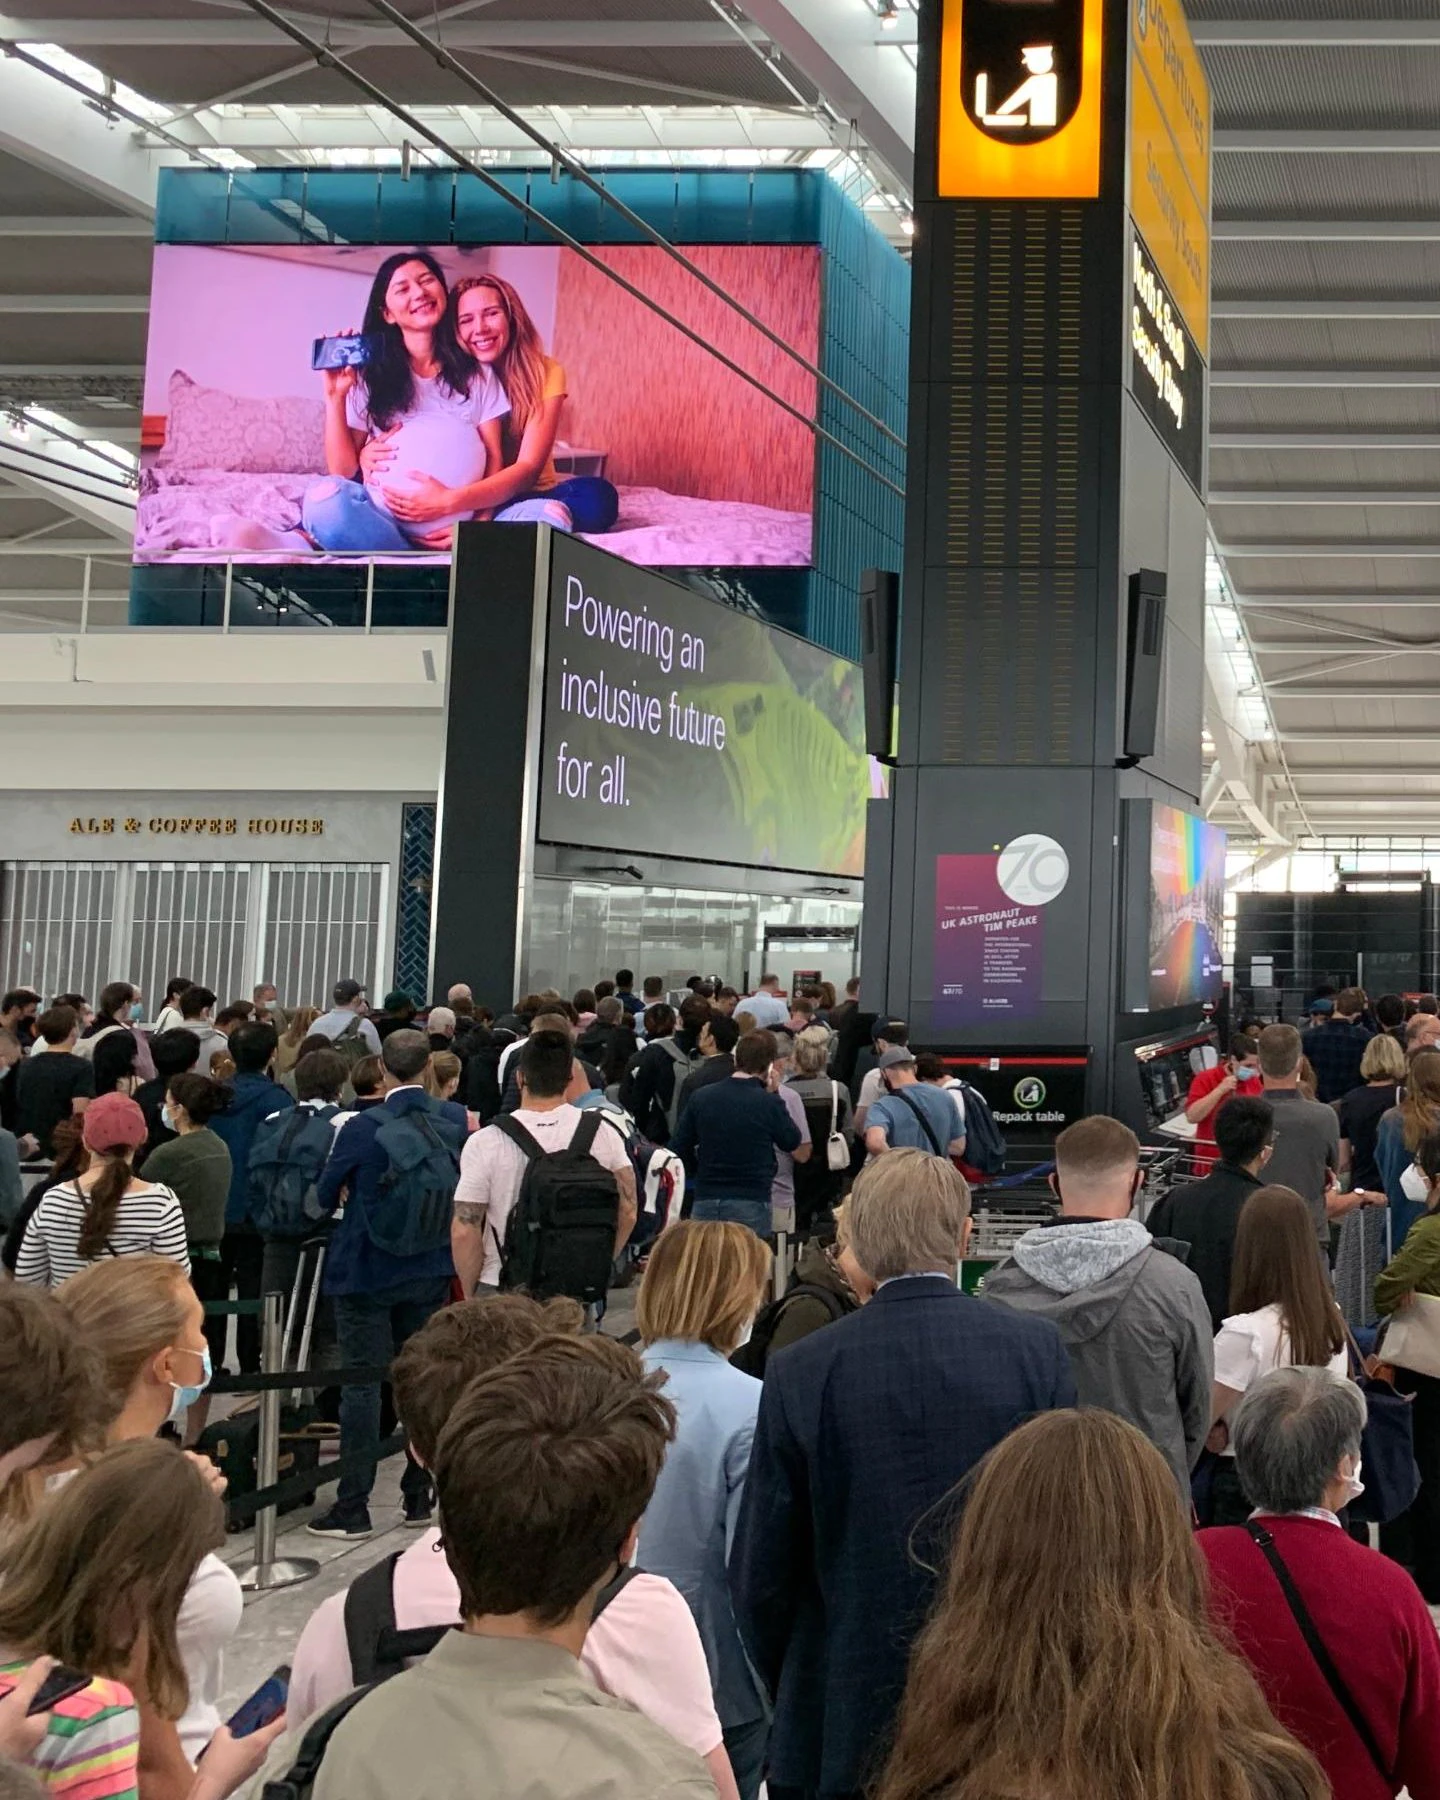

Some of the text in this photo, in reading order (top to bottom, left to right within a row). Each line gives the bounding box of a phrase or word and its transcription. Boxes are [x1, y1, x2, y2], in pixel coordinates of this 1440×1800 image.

[1133, 241, 1157, 318] North
[1163, 303, 1185, 371] South
[1132, 306, 1163, 399] Security
[565, 574, 705, 673] Powering an
[560, 658, 726, 751] inclusive future
[557, 741, 631, 806] for all.
[70, 817, 325, 836] ALE & COFFEE HOUSE
[1001, 841, 1069, 893] 70
[941, 907, 1022, 930] UK ASTRONAUT
[983, 915, 1039, 933] TIM PEAKE
[992, 1110, 1066, 1125] Repack table
